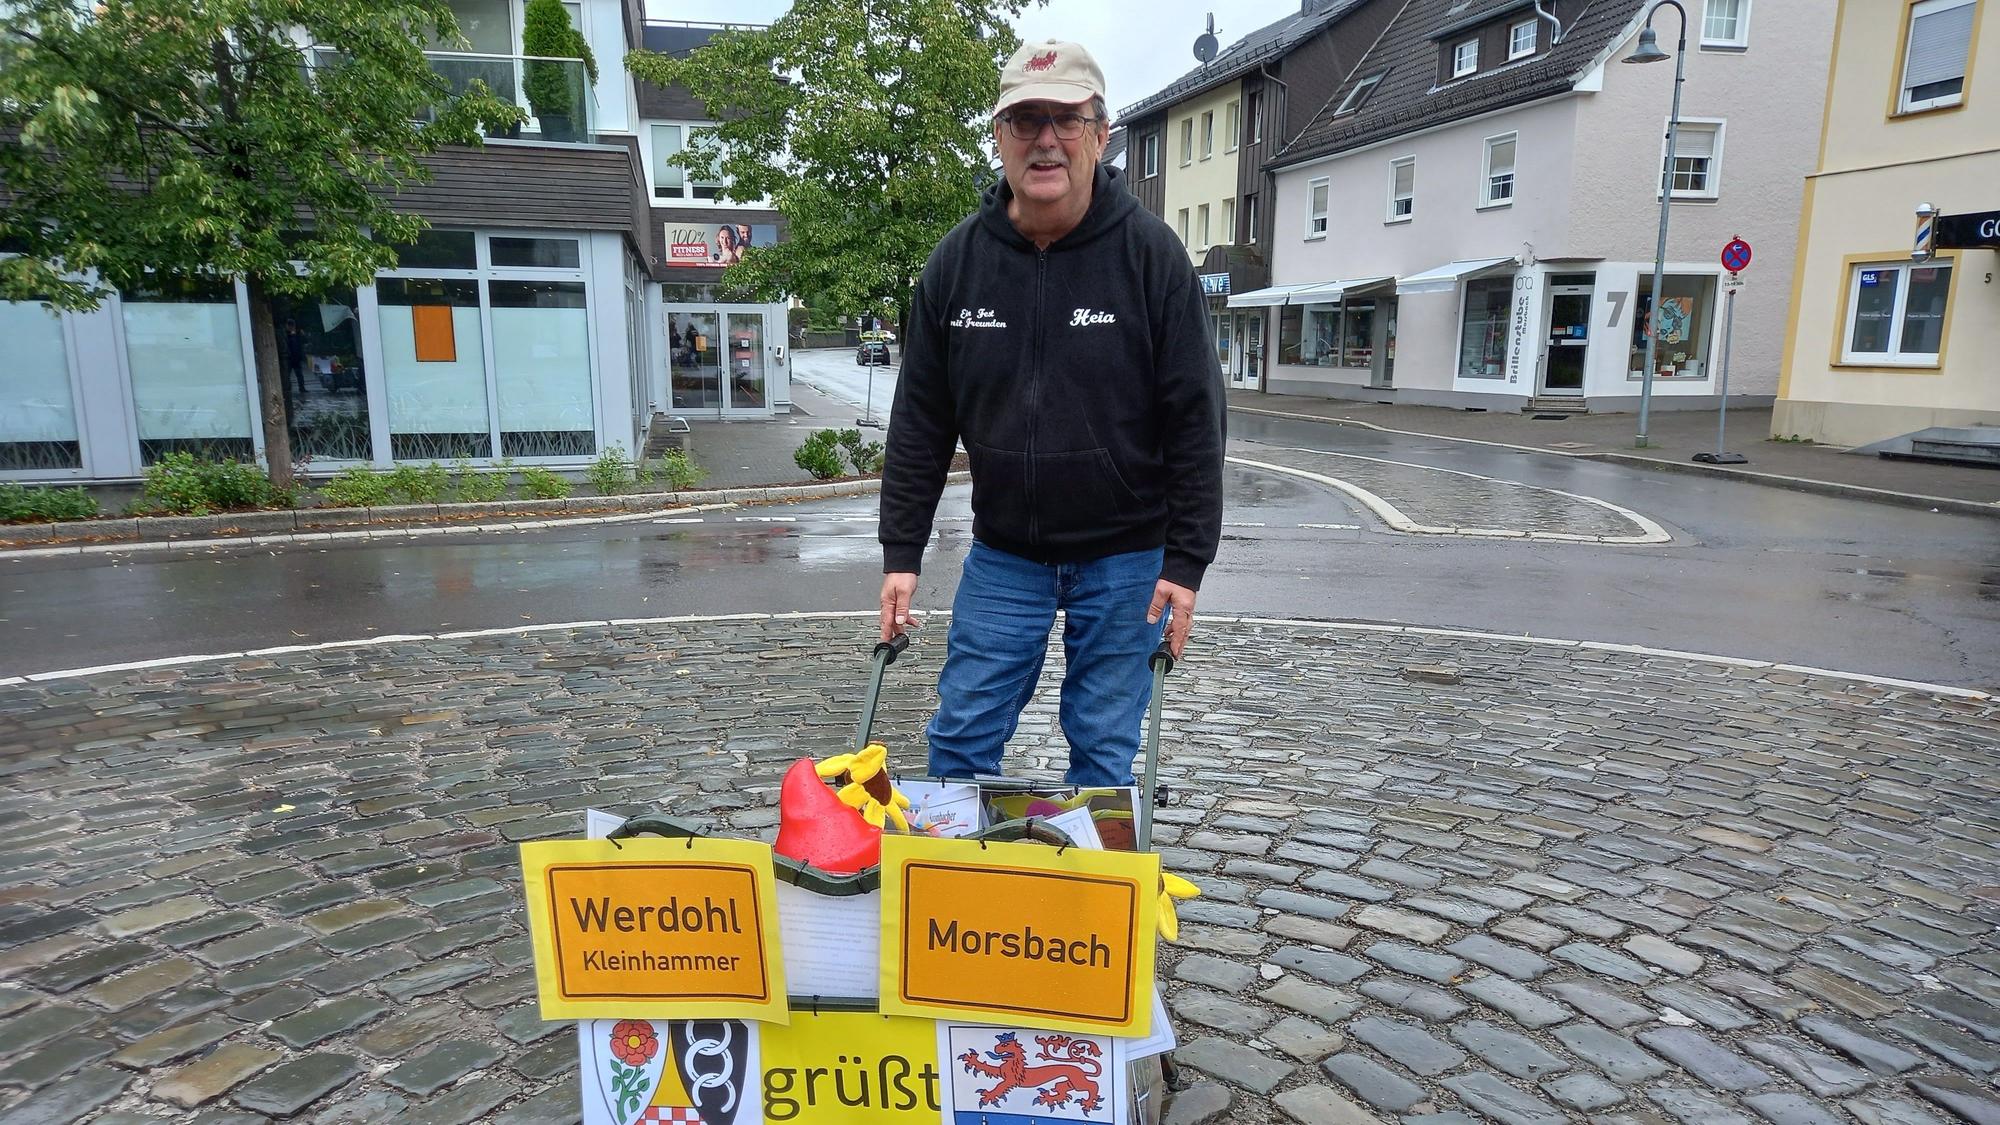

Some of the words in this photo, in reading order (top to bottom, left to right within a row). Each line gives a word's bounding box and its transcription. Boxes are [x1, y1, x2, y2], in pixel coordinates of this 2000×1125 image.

[671, 229, 706, 246] 100%
[673, 246, 705, 254] FITNESS
[1862, 273, 1875, 281] GLS
[1984, 272, 1992, 284] 5
[976, 308, 995, 319] Fest
[1069, 308, 1116, 327] Heia
[1606, 291, 1628, 328] 7
[965, 317, 1007, 328] Freunden
[570, 896, 742, 934] Werdohl
[928, 918, 1111, 969] Morsbach
[583, 950, 740, 972] Kleinhammer
[763, 1055, 941, 1121] grüßt
